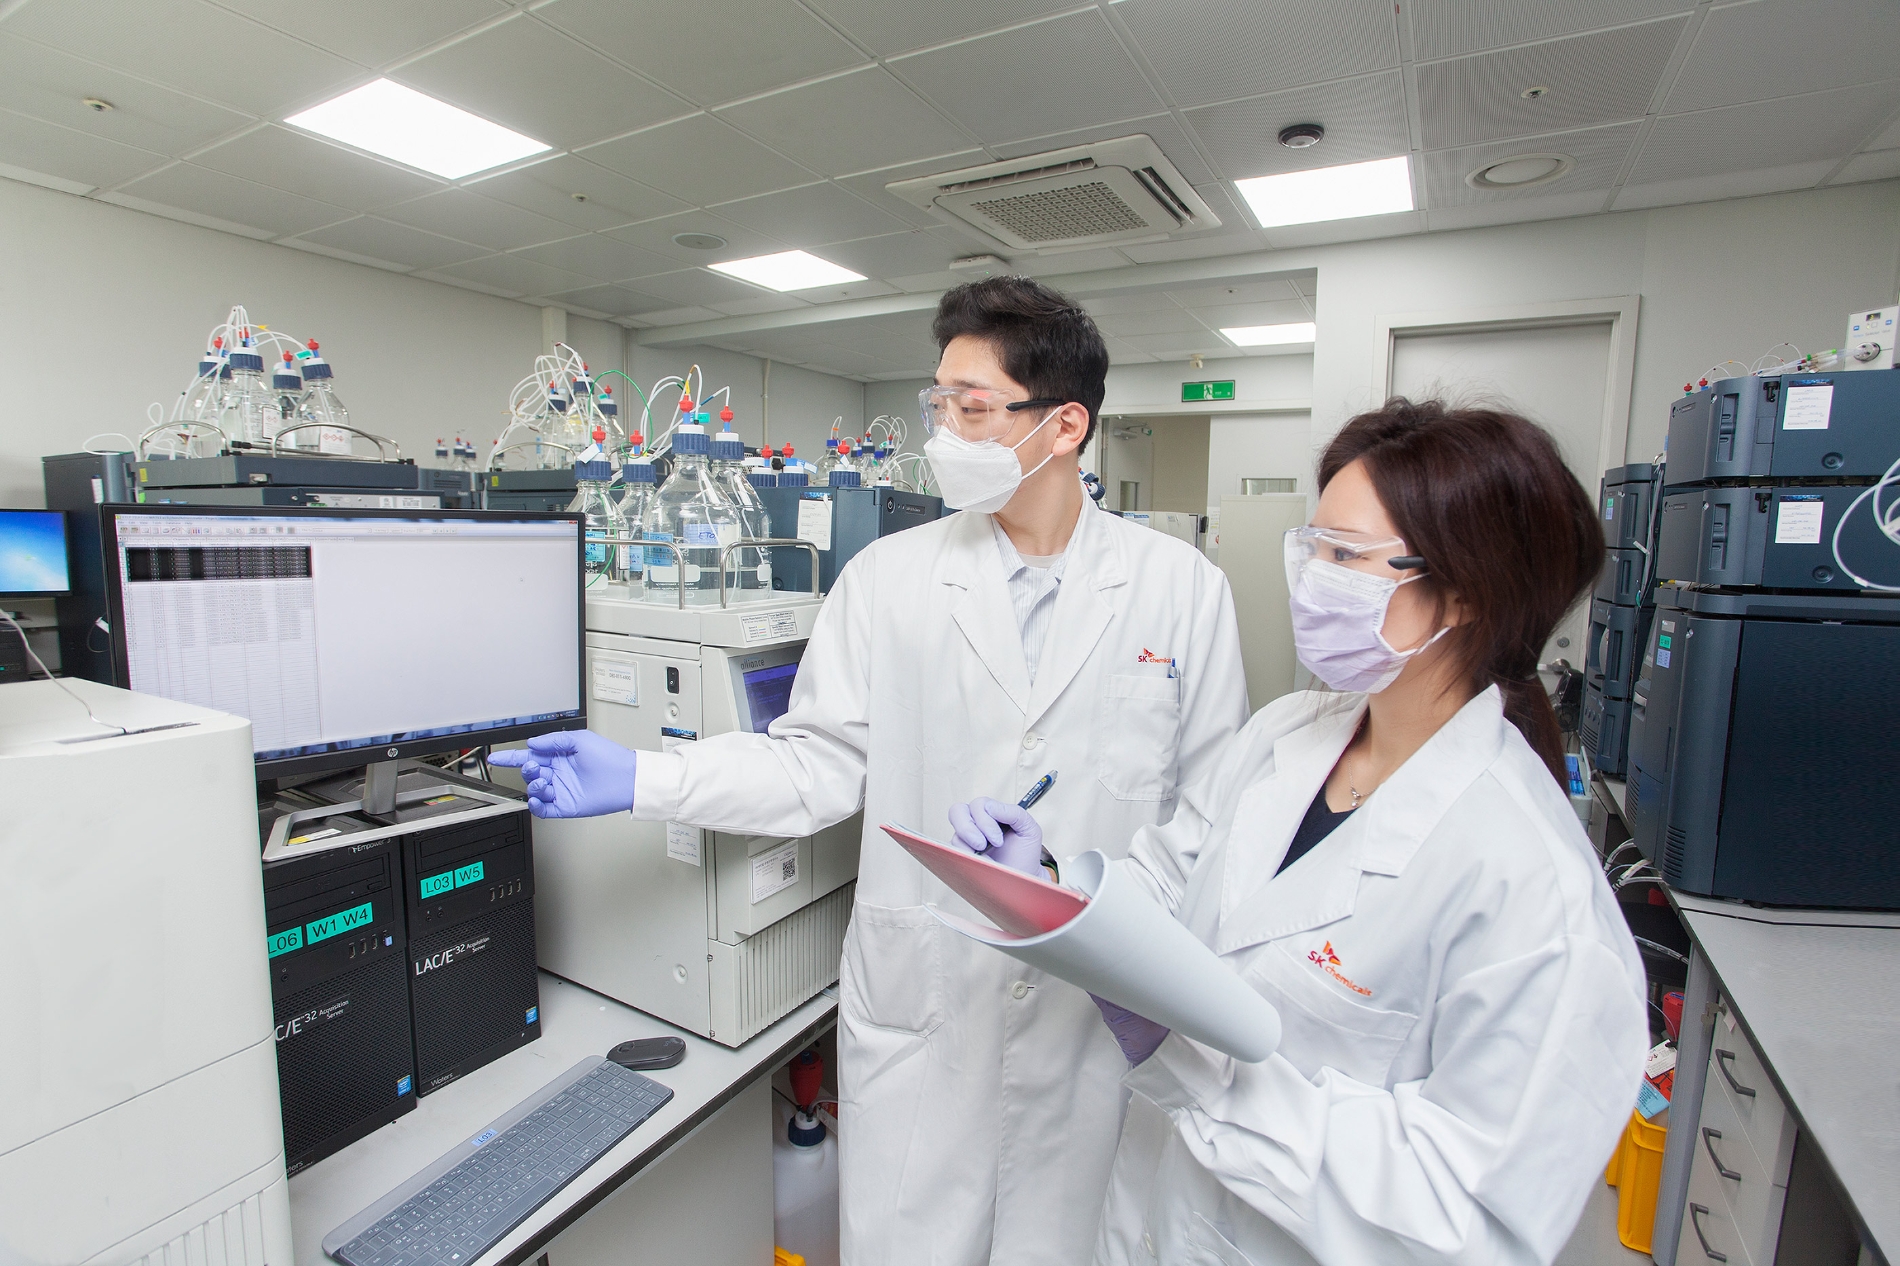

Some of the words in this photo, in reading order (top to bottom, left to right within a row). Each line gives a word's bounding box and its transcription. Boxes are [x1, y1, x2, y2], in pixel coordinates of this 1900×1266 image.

[1138, 655, 1148, 663] SK
[357, 840, 385, 852] Empower
[426, 876, 450, 893] L03
[459, 866, 481, 882] W5
[267, 932, 298, 954] L06
[312, 919, 337, 938] W1
[343, 908, 368, 926] W4
[1307, 950, 1326, 968] SK
[319, 1000, 349, 1016] Acquisition
[326, 1009, 344, 1020] Server
[478, 1132, 493, 1144] L03
